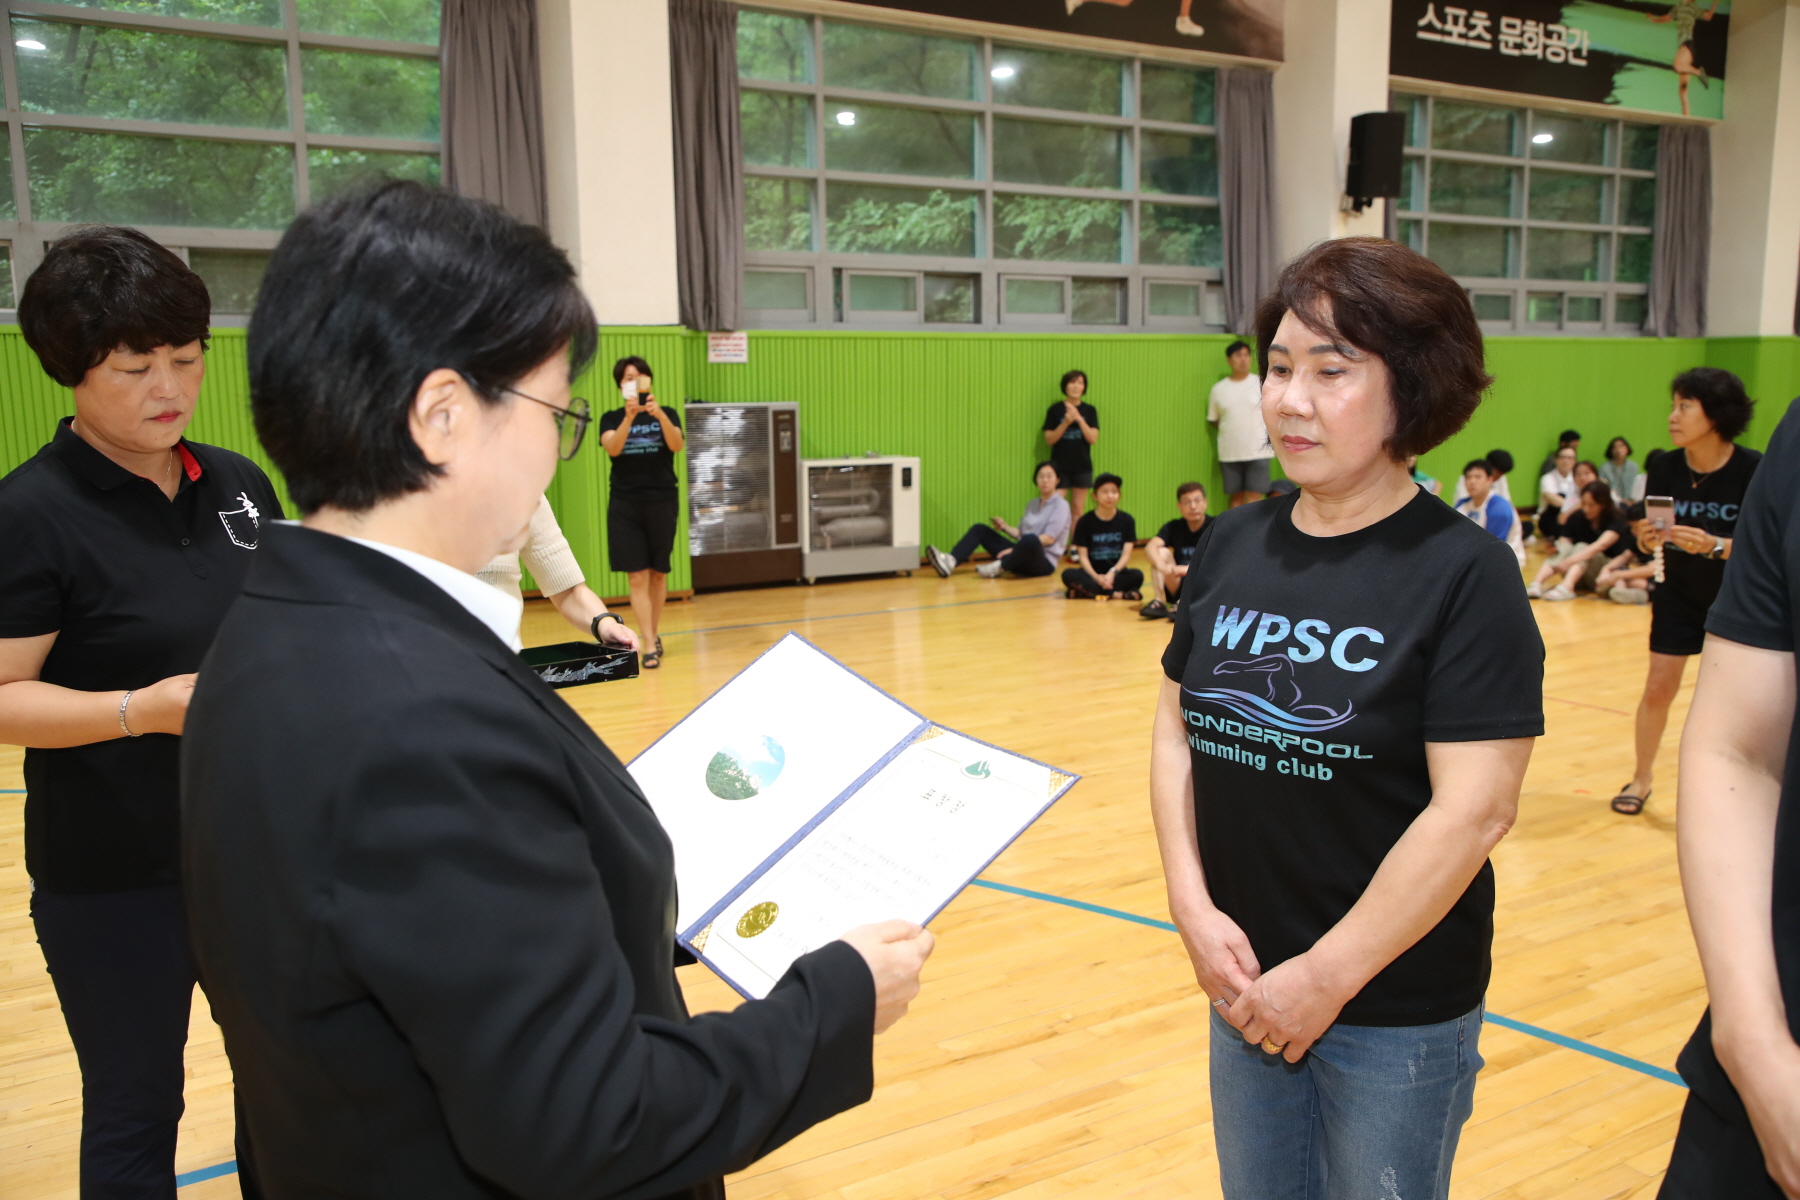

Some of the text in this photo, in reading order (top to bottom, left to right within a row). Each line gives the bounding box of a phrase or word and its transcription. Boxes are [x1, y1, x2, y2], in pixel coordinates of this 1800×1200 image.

[1416, 2, 1589, 66] 스포츠 문화공간
[1211, 605, 1385, 672] WPSC
[1277, 757, 1333, 780] club
